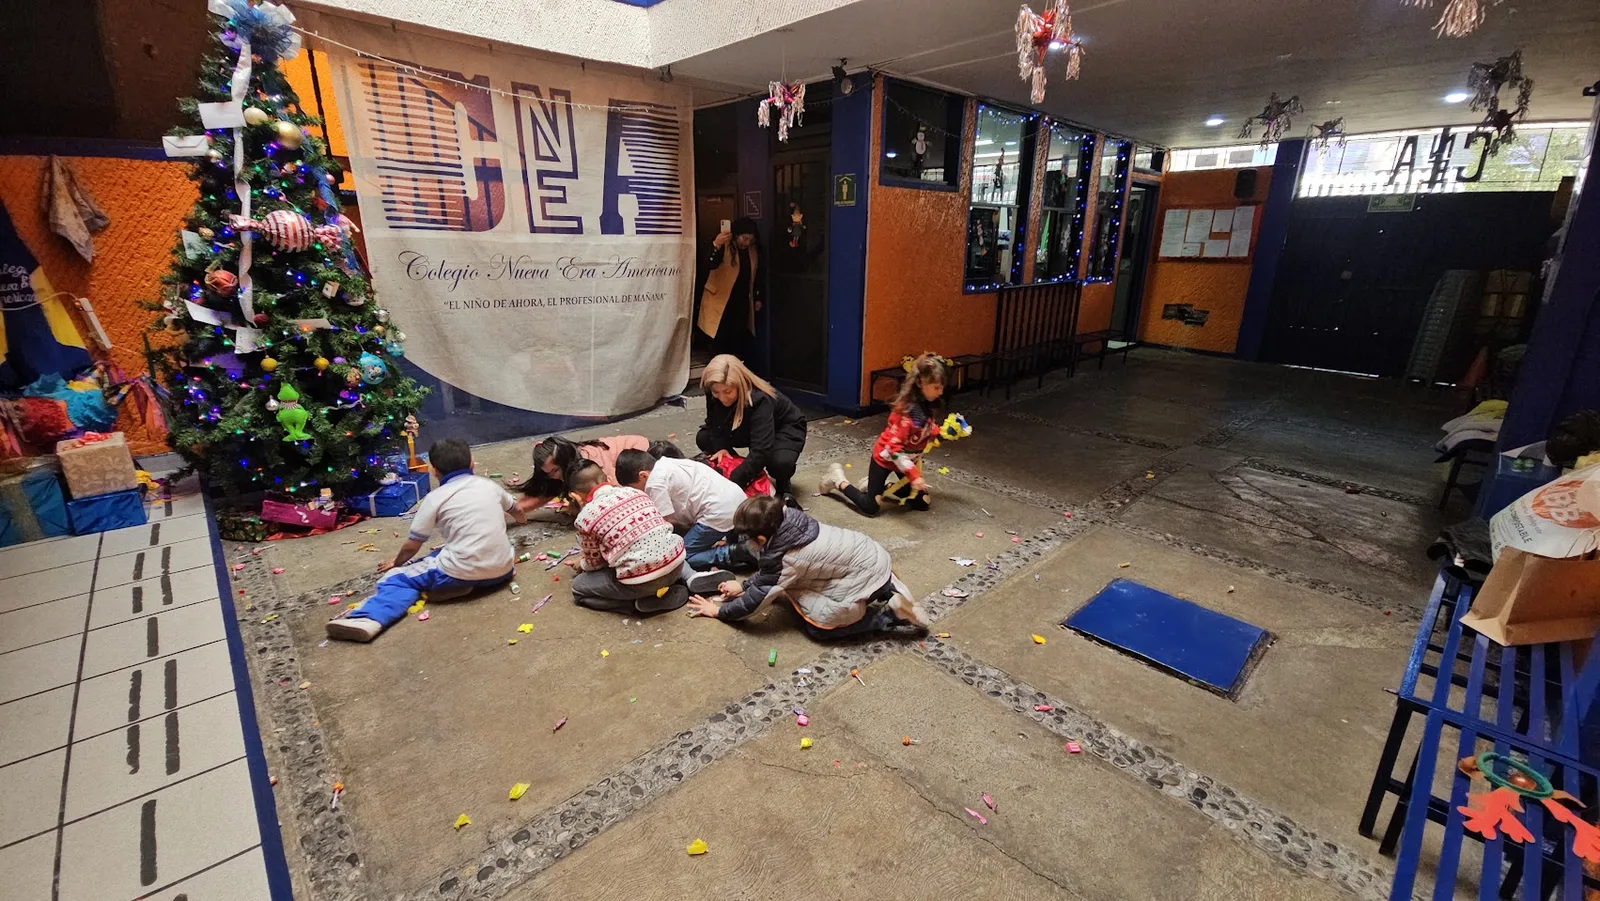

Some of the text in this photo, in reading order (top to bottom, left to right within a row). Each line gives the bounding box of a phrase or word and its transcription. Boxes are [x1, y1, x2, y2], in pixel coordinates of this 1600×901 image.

[397, 250, 682, 293] Colegio Nueva Era Americano
[463, 297, 491, 310] NIÑO
[493, 299, 507, 309] DE
[507, 298, 546, 309] AHORA,
[547, 297, 558, 308] EL
[559, 295, 620, 307] PROFESIONAL
[621, 294, 632, 304] DE
